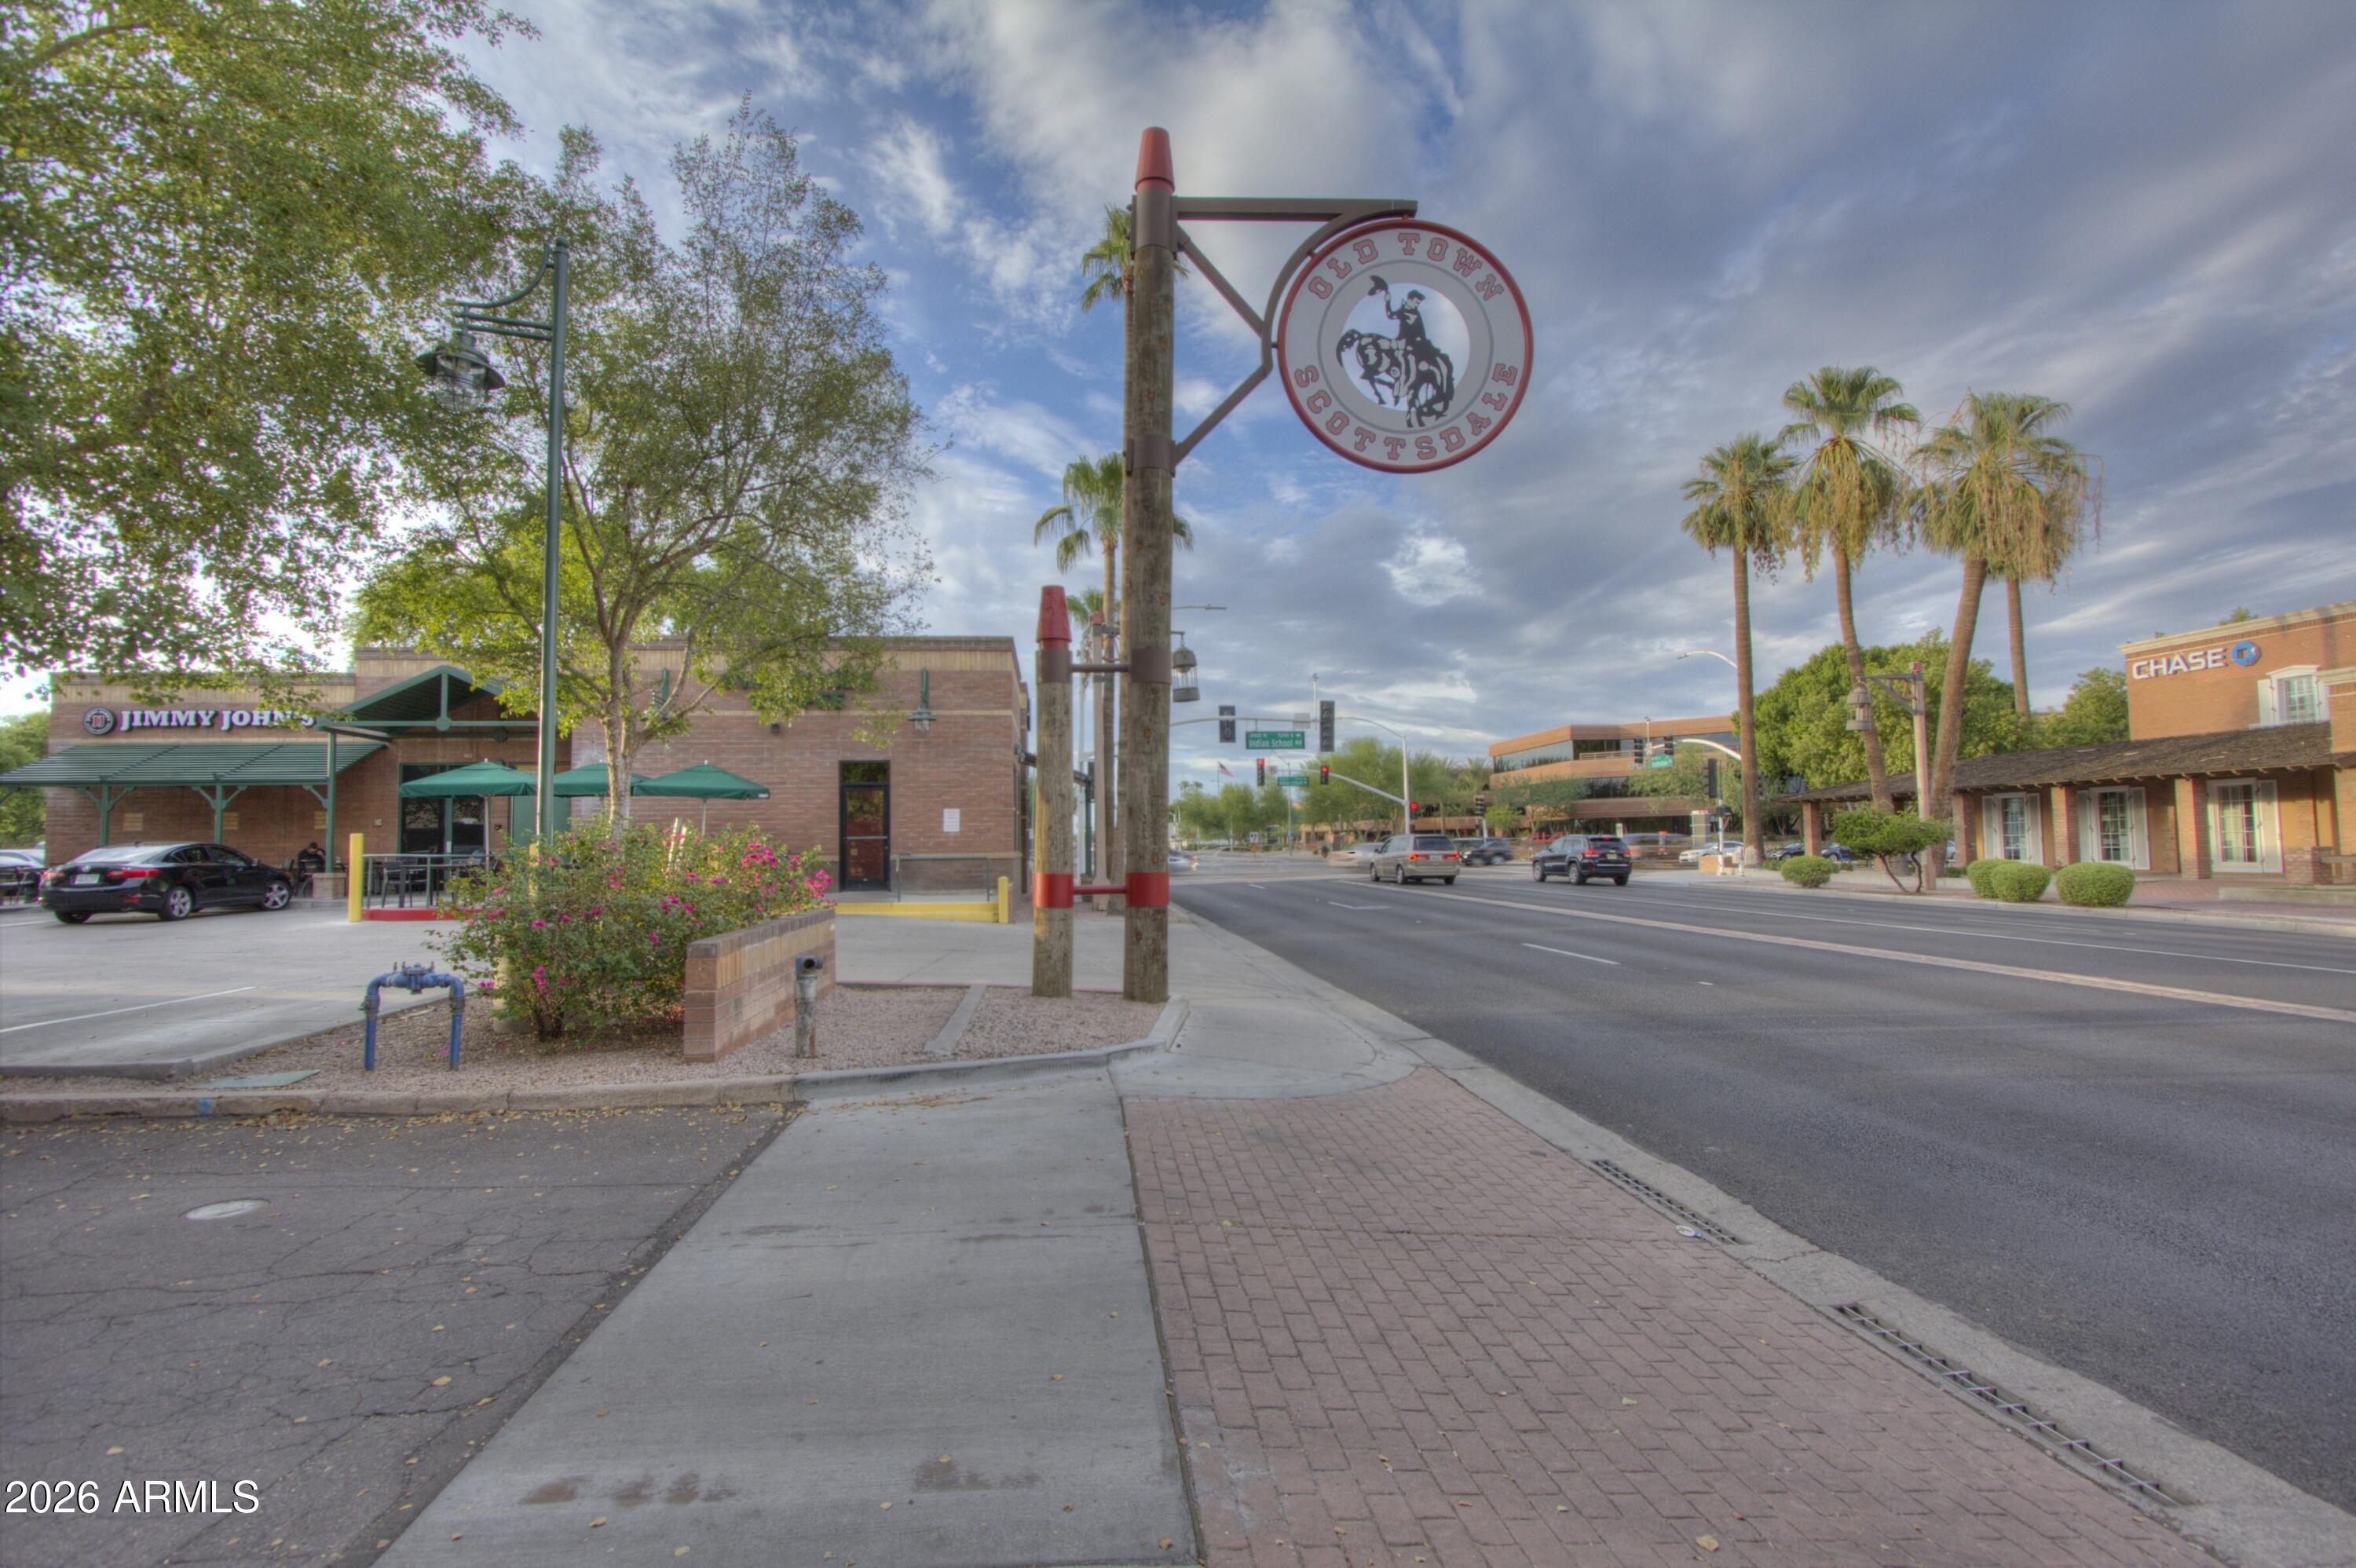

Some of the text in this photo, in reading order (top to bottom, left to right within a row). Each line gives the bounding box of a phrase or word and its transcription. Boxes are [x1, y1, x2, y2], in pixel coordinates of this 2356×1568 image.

[1308, 232, 1504, 301] OLD TOWN
[1293, 363, 1518, 460] SCOTTSDALE
[2132, 647, 2228, 679] CHASE
[119, 710, 216, 731] JIMMY
[1249, 739, 1269, 748] Indian
[1271, 739, 1293, 748] School
